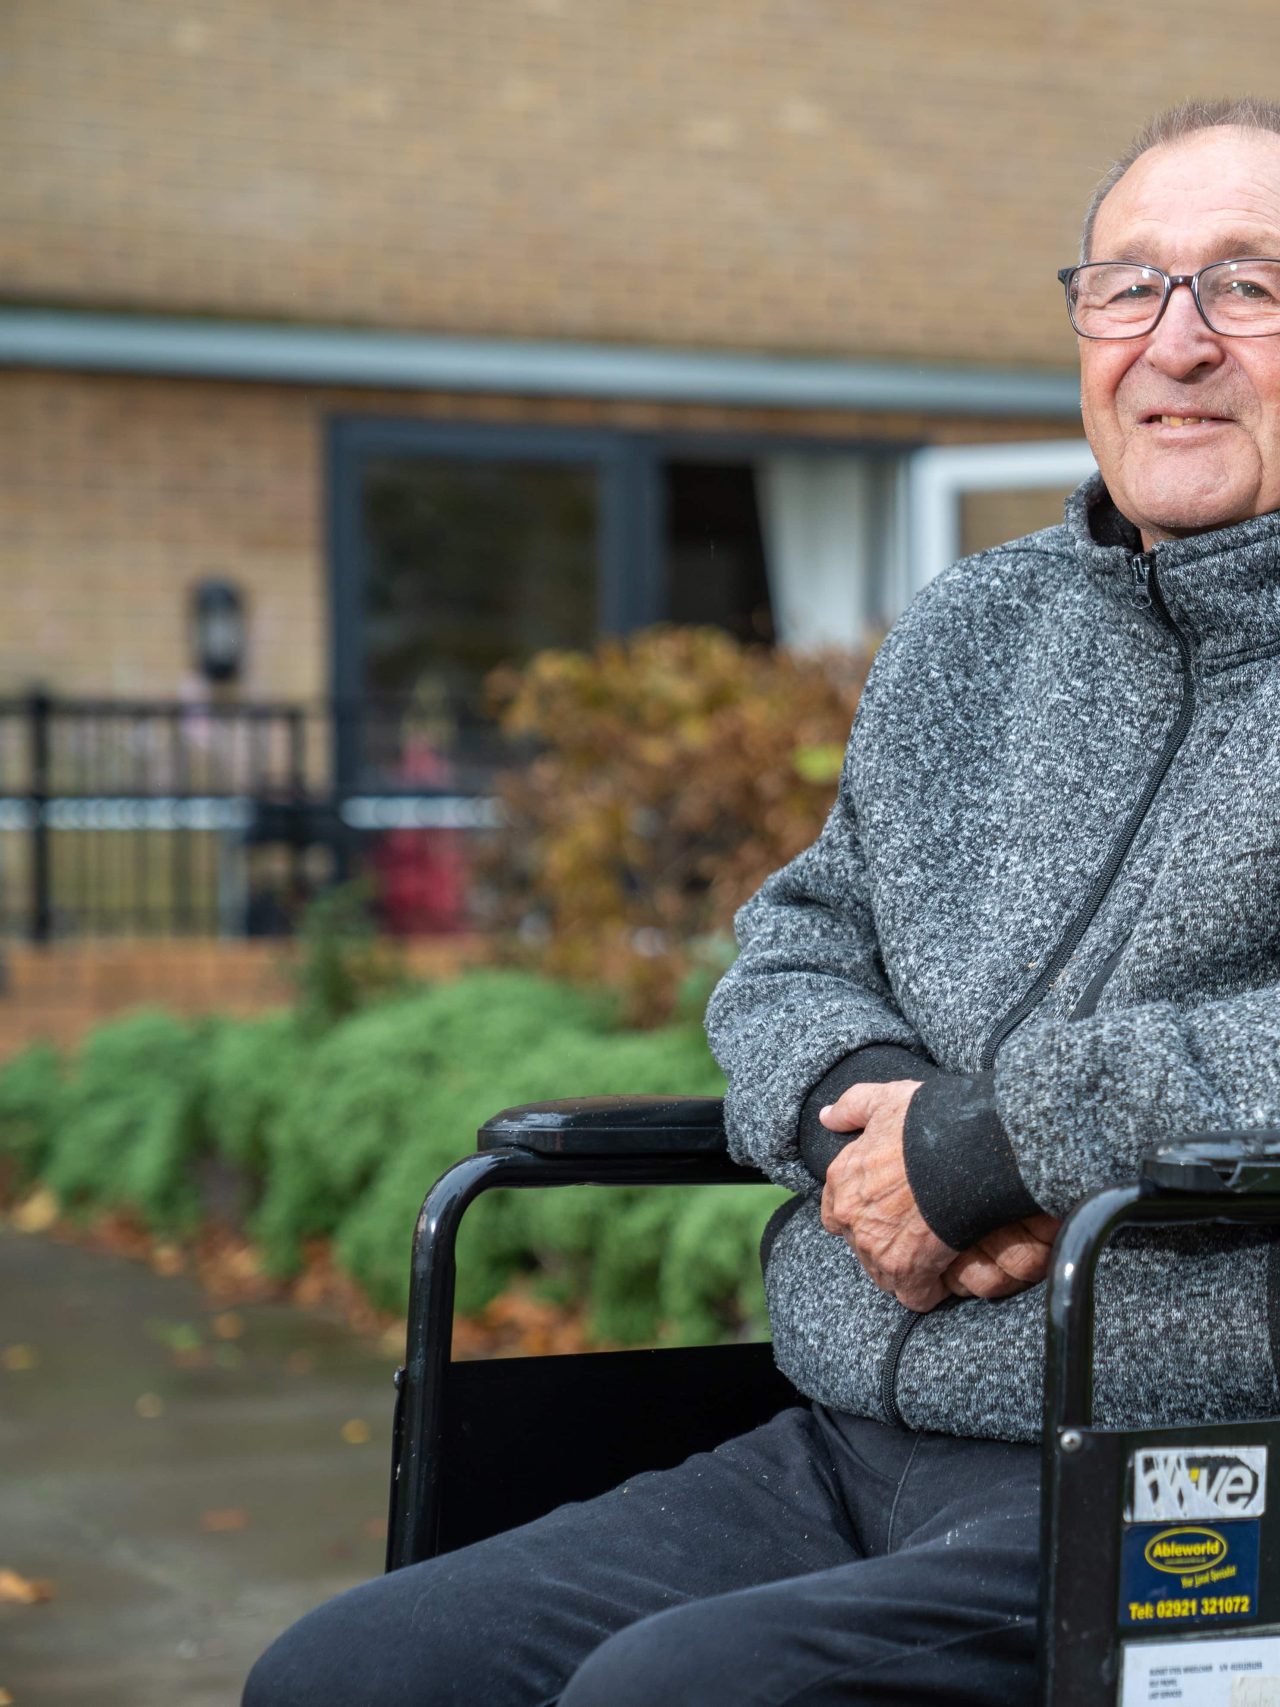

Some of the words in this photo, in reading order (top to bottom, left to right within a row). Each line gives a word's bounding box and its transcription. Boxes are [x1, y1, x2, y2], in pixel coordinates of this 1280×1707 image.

[1153, 1540, 1220, 1558] Ableworld
[1129, 1602, 1154, 1621] Tel:
[1156, 1598, 1197, 1619] 02921
[1201, 1595, 1250, 1615] 321072
